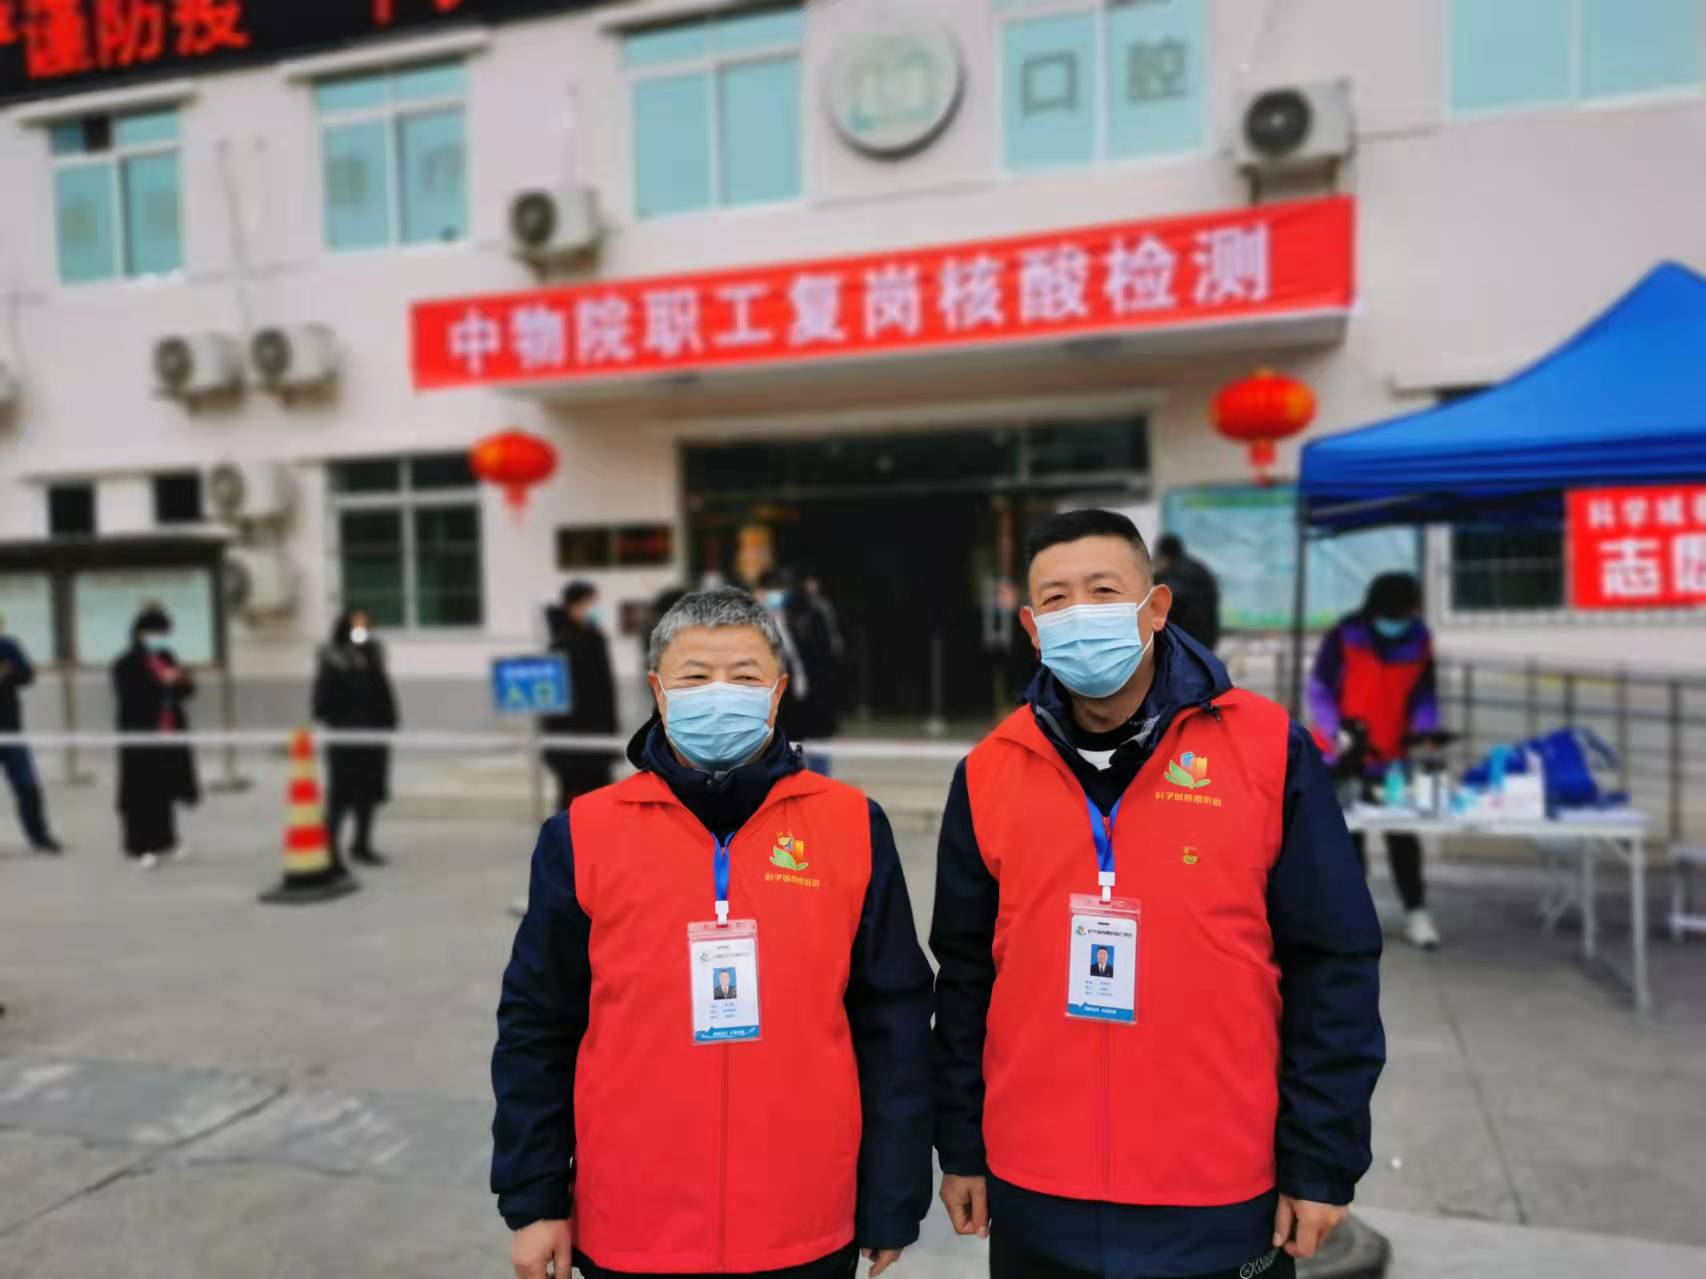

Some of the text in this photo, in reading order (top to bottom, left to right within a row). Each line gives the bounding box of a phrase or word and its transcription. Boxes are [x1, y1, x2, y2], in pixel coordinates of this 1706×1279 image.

[448, 221, 1271, 374] 中物院职工复岗核酸检测
